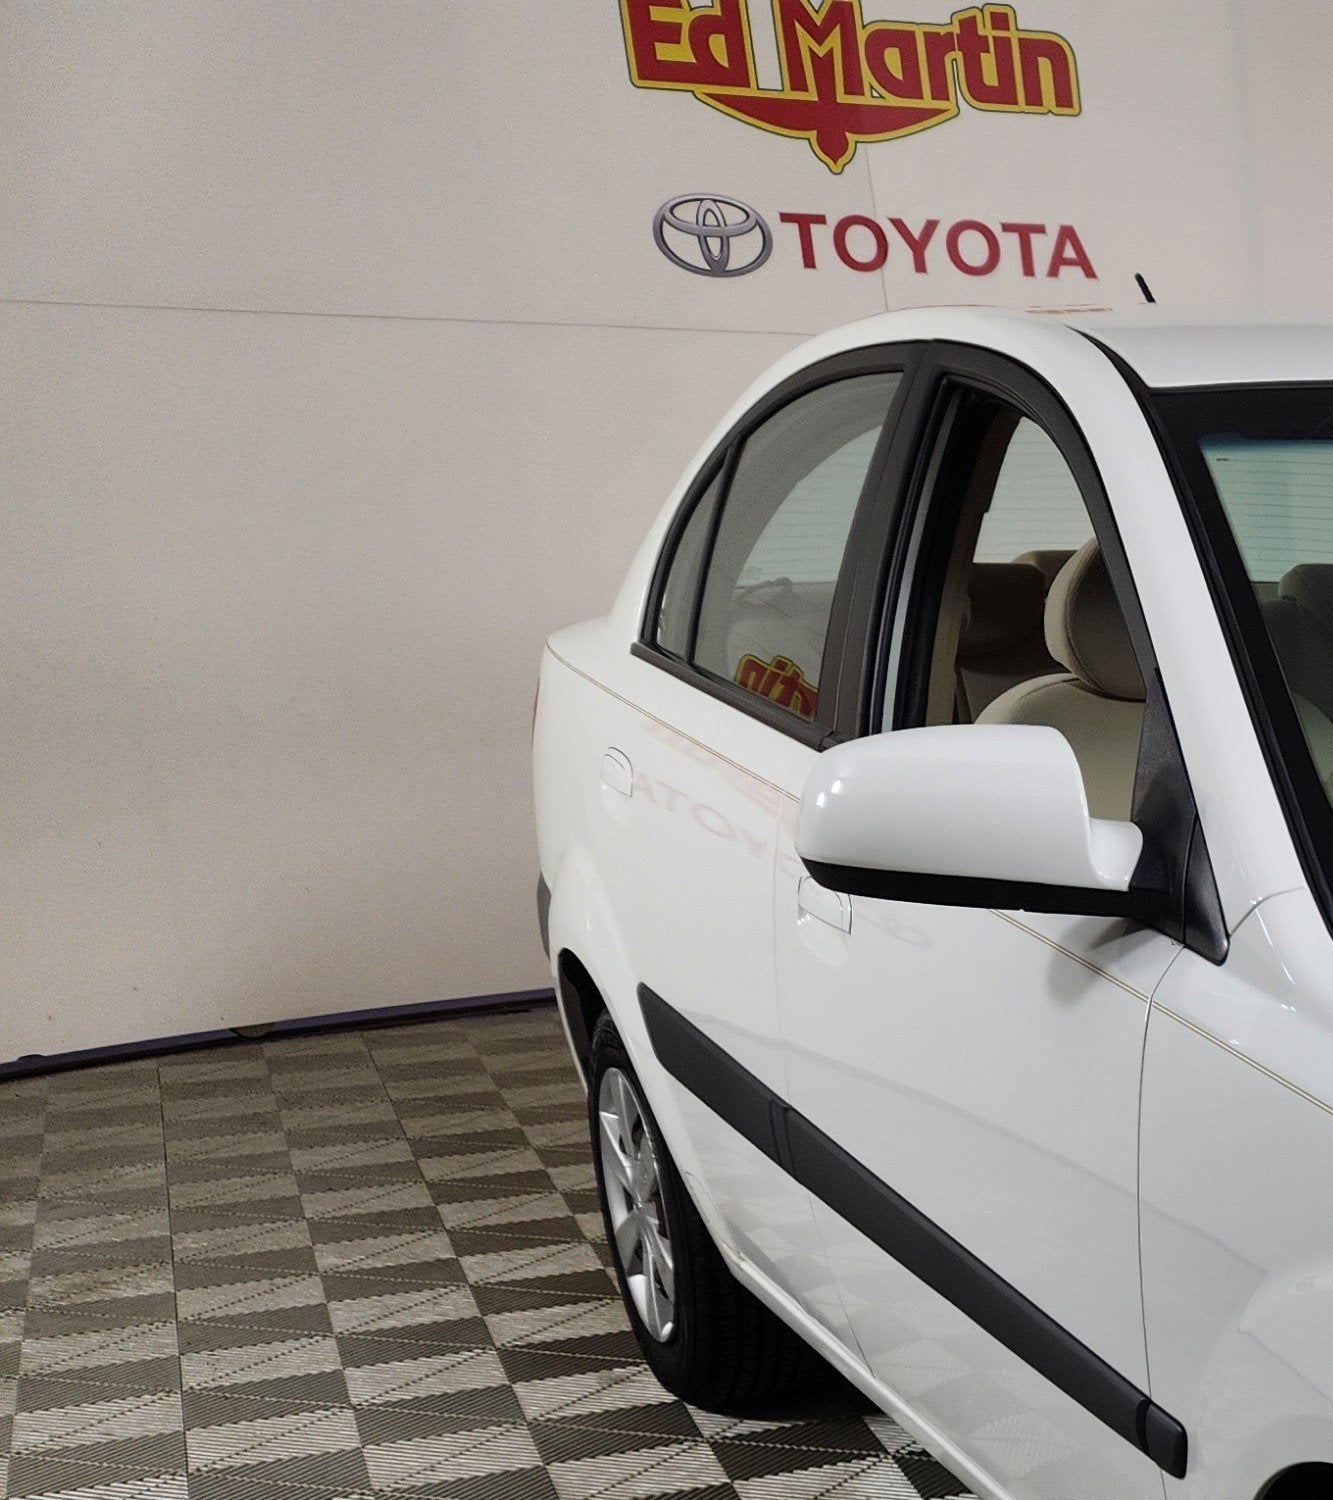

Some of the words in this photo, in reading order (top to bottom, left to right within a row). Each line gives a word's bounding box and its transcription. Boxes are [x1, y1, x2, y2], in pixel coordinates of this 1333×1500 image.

[626, 0, 752, 88] Ed
[779, 0, 1075, 109] Martin
[780, 212, 1098, 279] TOYOTA
